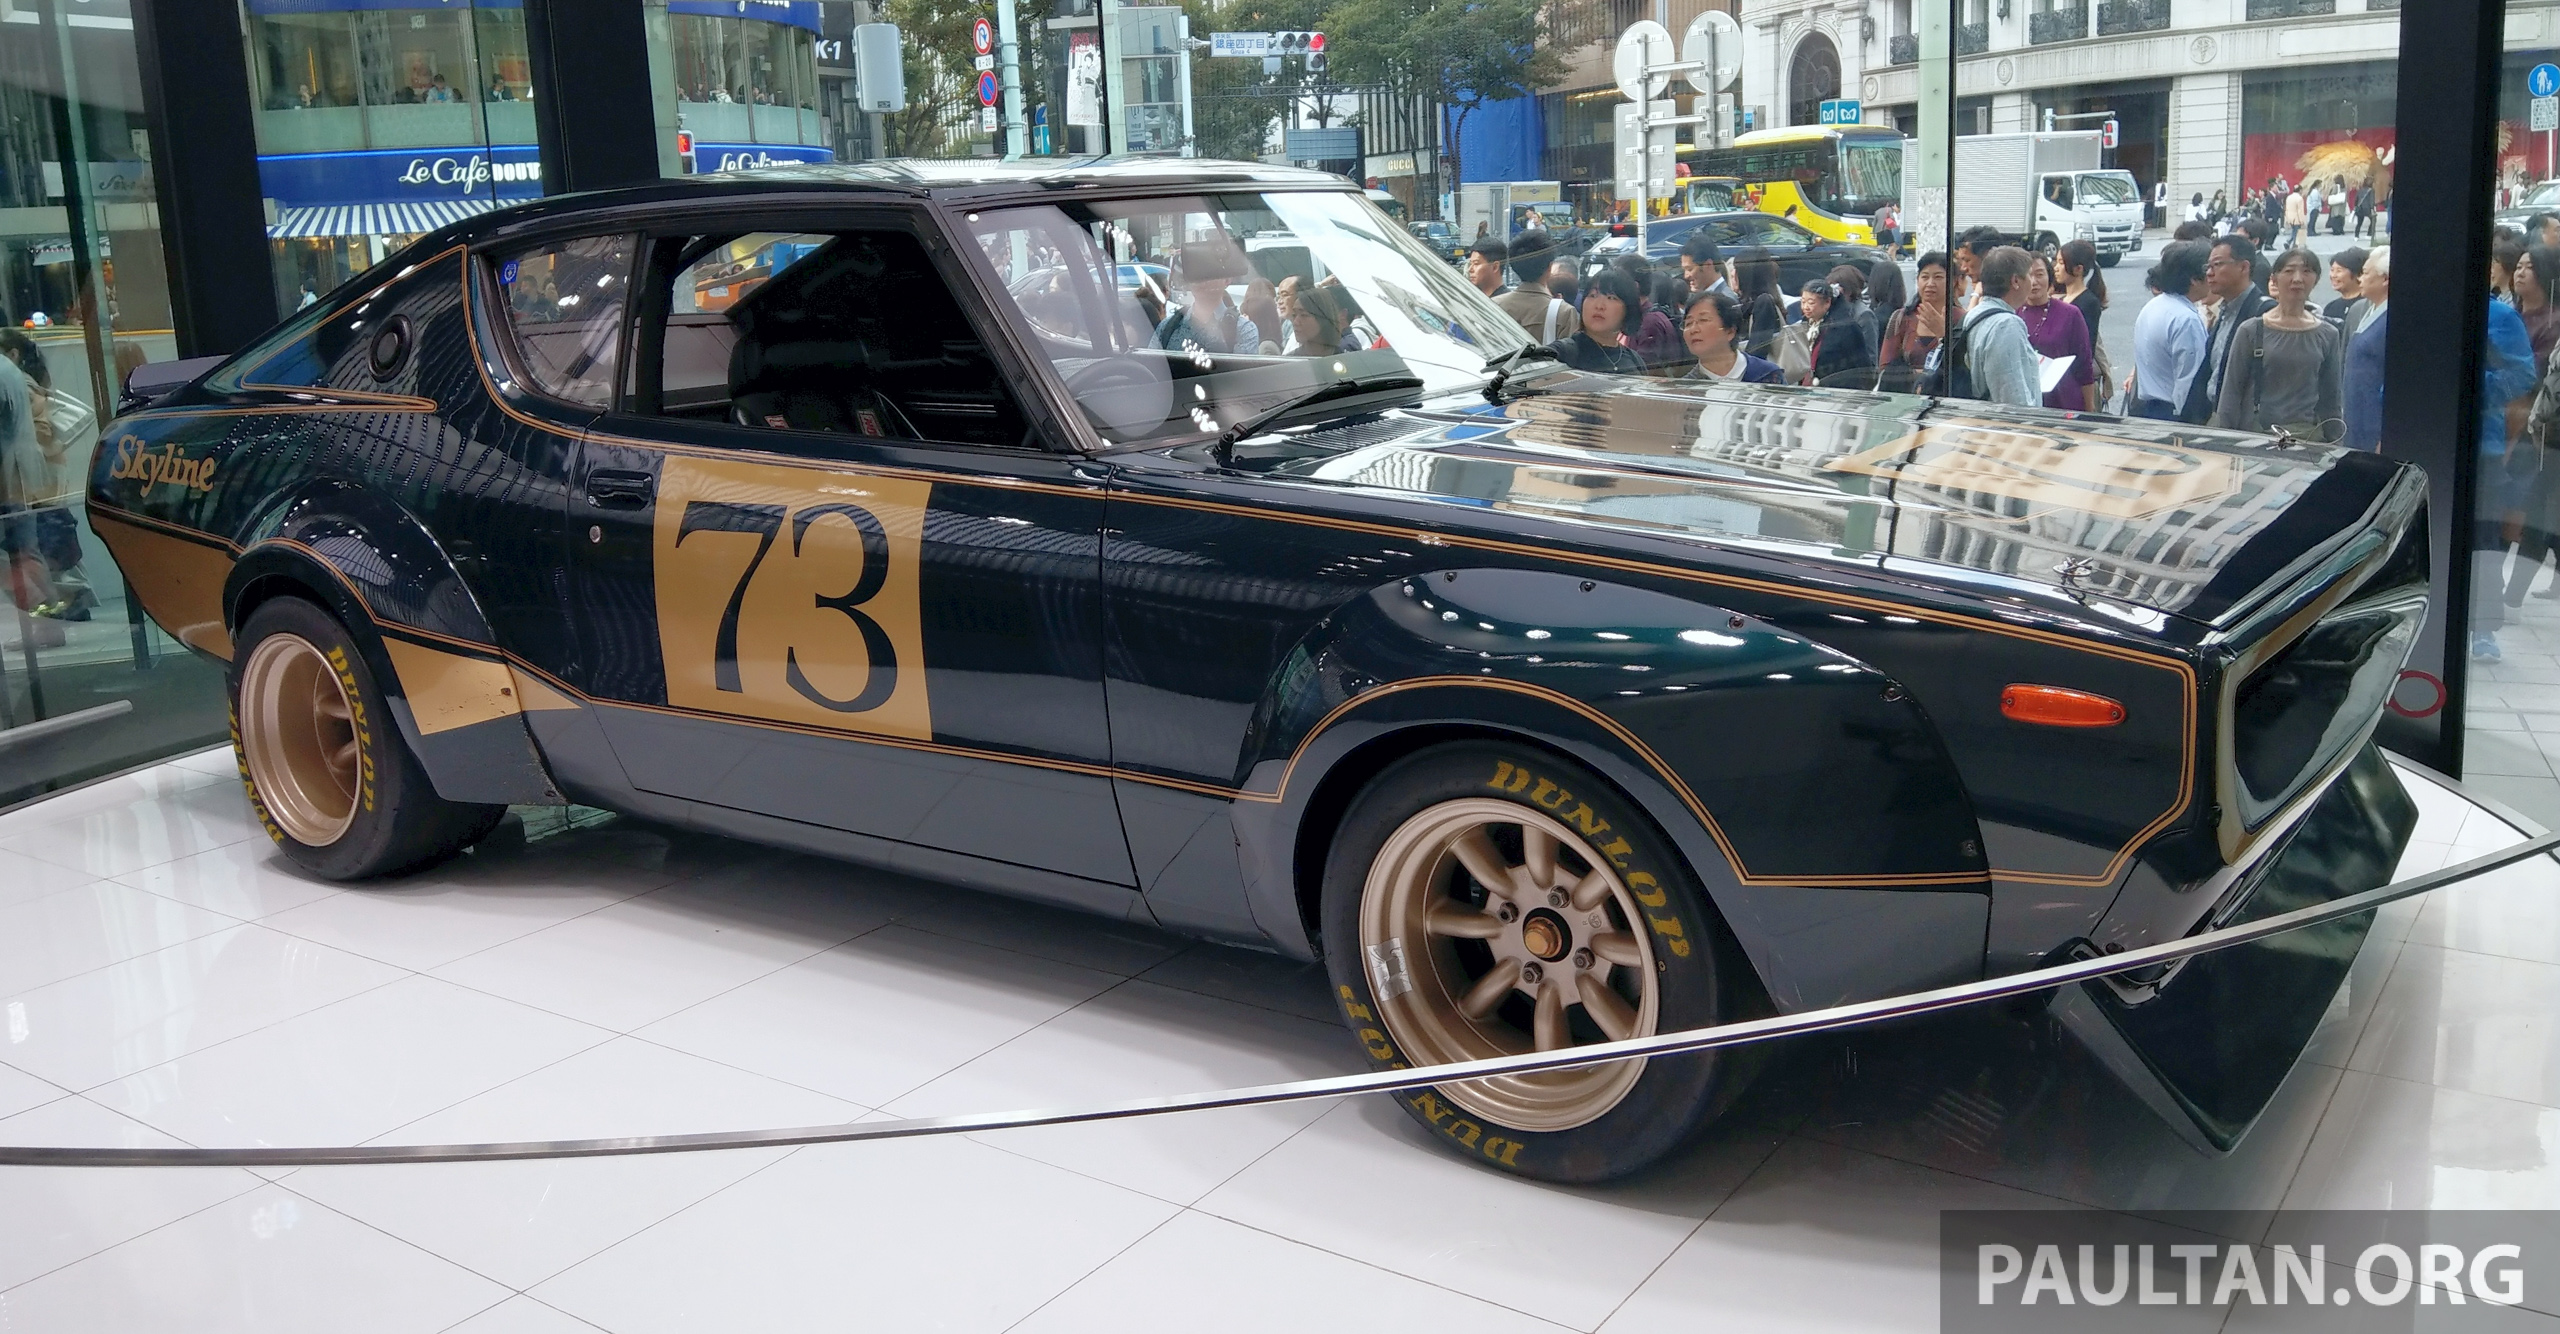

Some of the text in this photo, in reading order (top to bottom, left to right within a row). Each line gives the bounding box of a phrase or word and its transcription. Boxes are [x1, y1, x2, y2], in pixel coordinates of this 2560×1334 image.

[1215, 39, 1265, 49] 銀座四丁目
[399, 155, 543, 194] Le Café DOUT
[1388, 158, 1415, 171] GUCCI
[110, 433, 216, 499] Skyline
[675, 500, 898, 714] 73
[327, 645, 377, 812] DUNLOP
[1486, 760, 1692, 958] DUNLOP
[1339, 985, 1525, 1167] DUNOP
